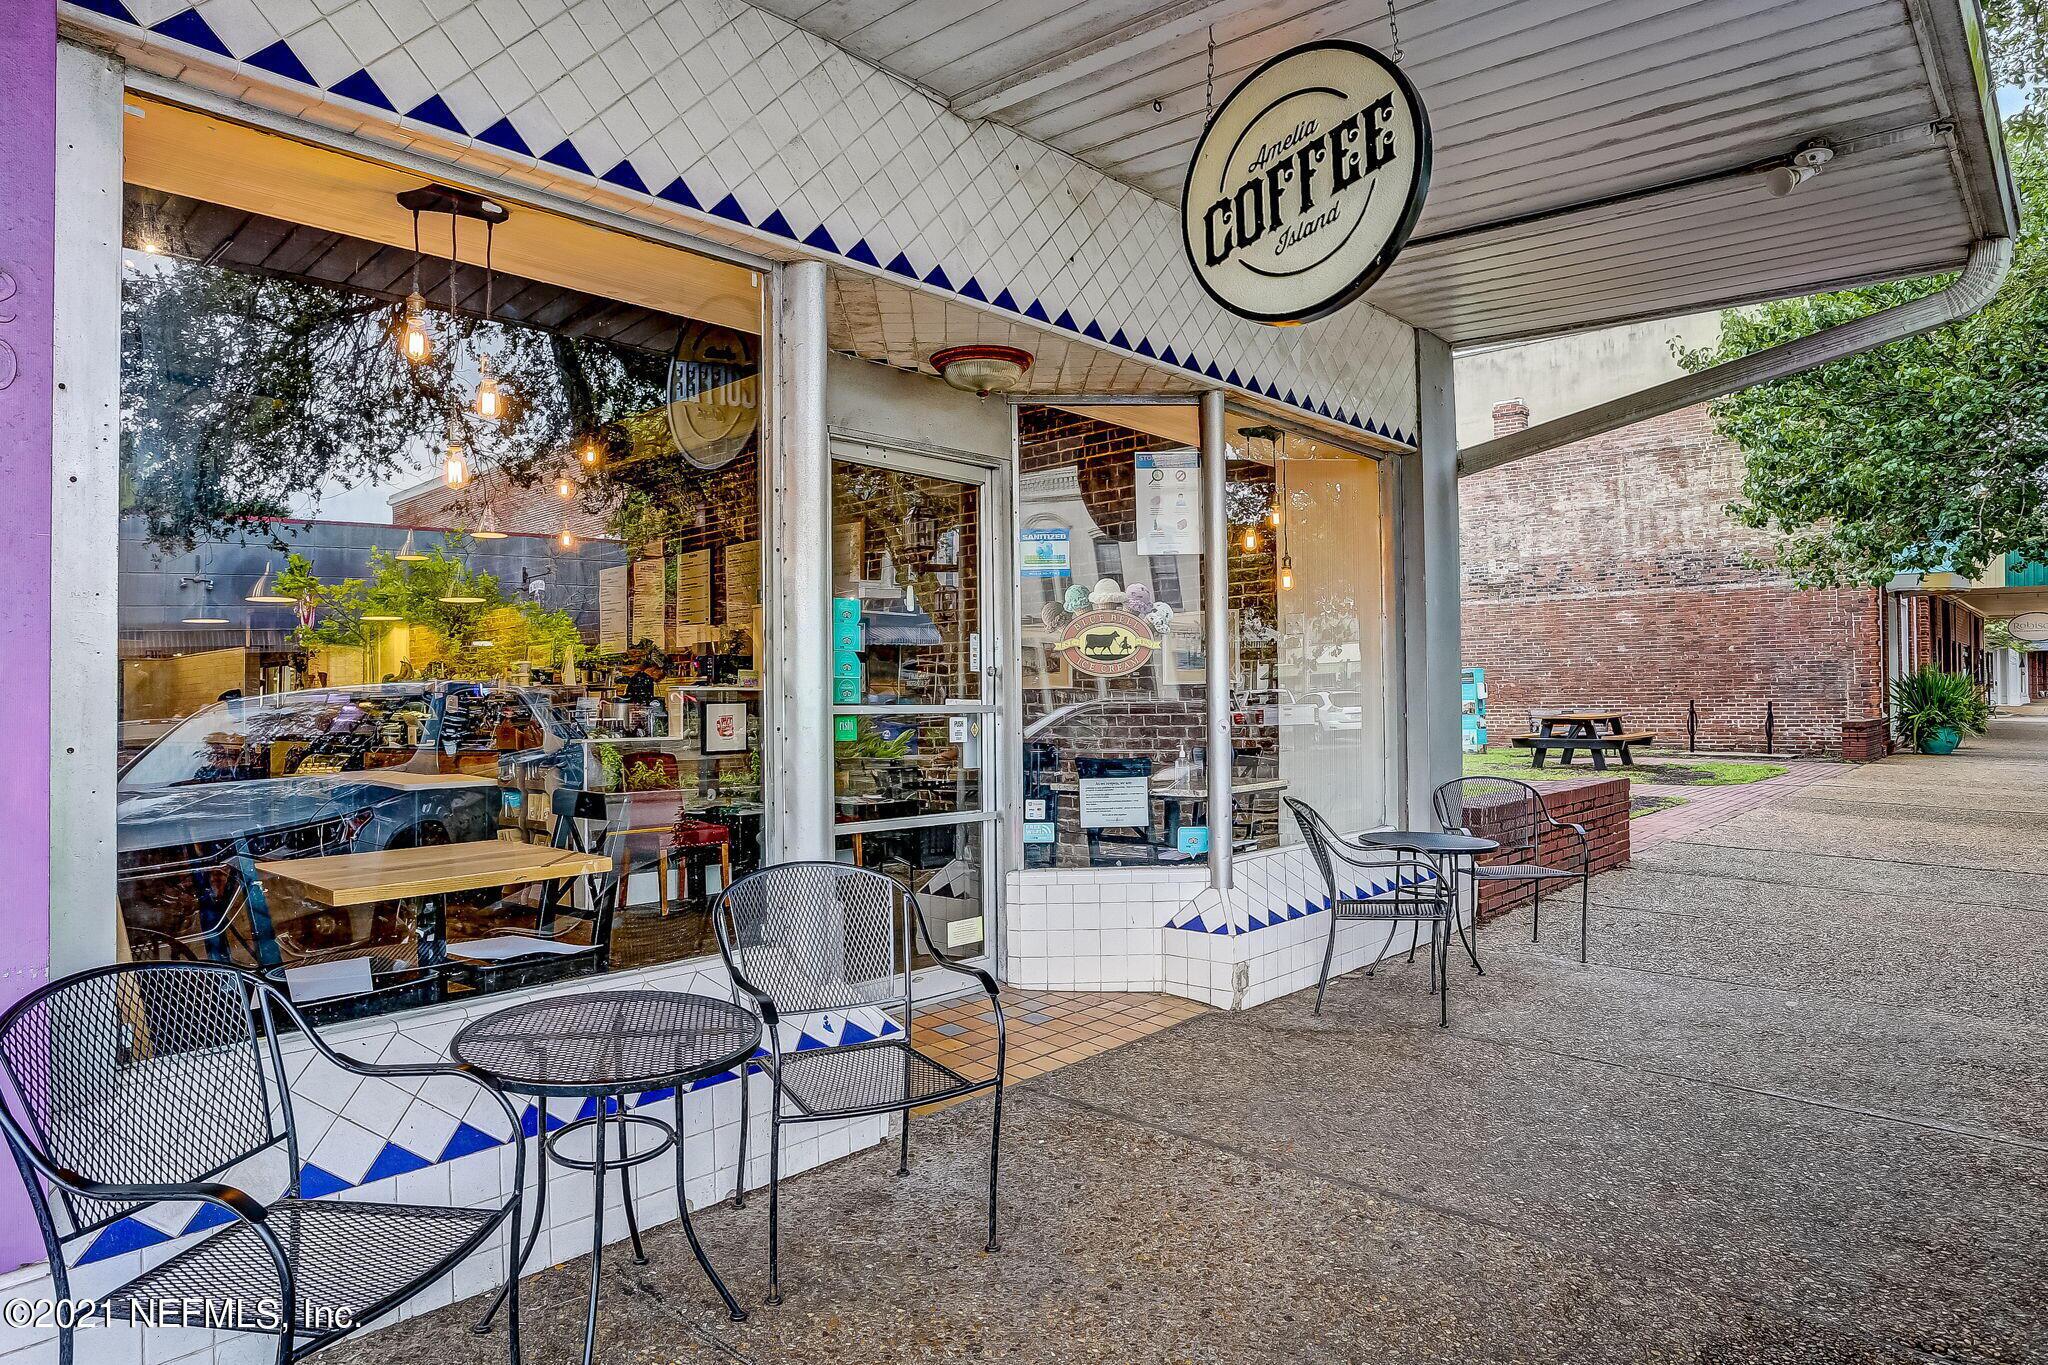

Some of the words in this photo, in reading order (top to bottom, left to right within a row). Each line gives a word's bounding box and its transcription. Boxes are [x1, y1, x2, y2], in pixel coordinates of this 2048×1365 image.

[1248, 118, 1320, 173] Amelia
[1202, 90, 1397, 267] COFFEE
[1274, 201, 1341, 256] Island
[1073, 614, 1104, 631] BLUE
[1111, 614, 1140, 631] BELL
[1077, 657, 1095, 671] ICE
[1101, 656, 1141, 673] CREAM
